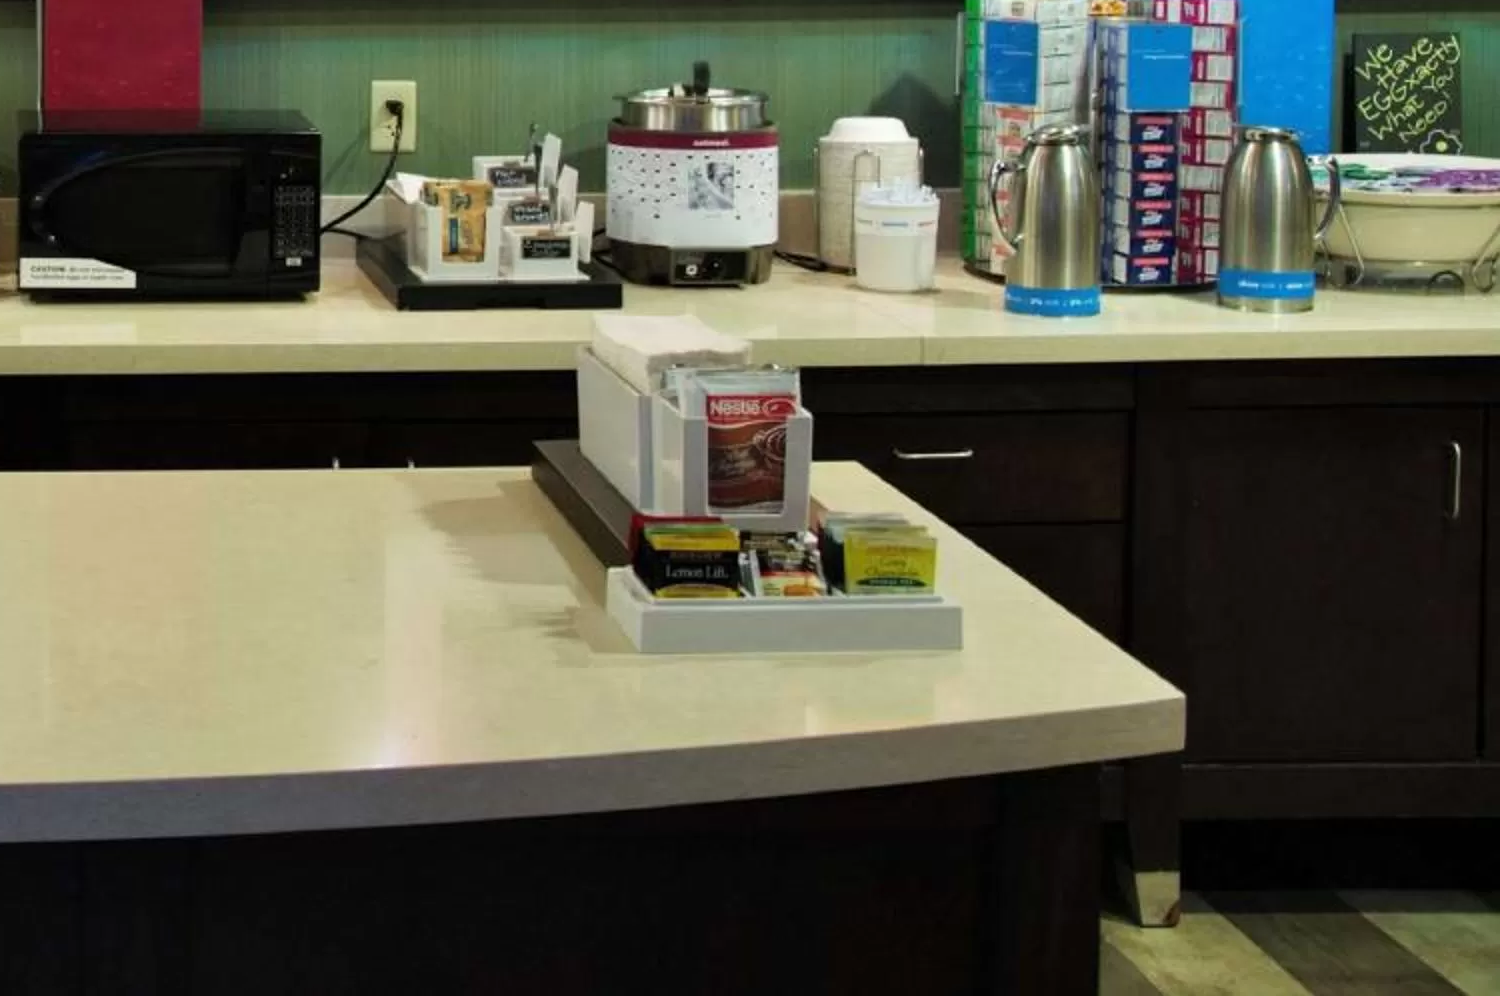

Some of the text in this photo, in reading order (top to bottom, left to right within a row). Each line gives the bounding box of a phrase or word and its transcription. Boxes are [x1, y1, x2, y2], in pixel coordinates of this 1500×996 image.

[1355, 44, 1393, 80] We
[1376, 38, 1433, 90] Have
[1367, 94, 1425, 140] What
